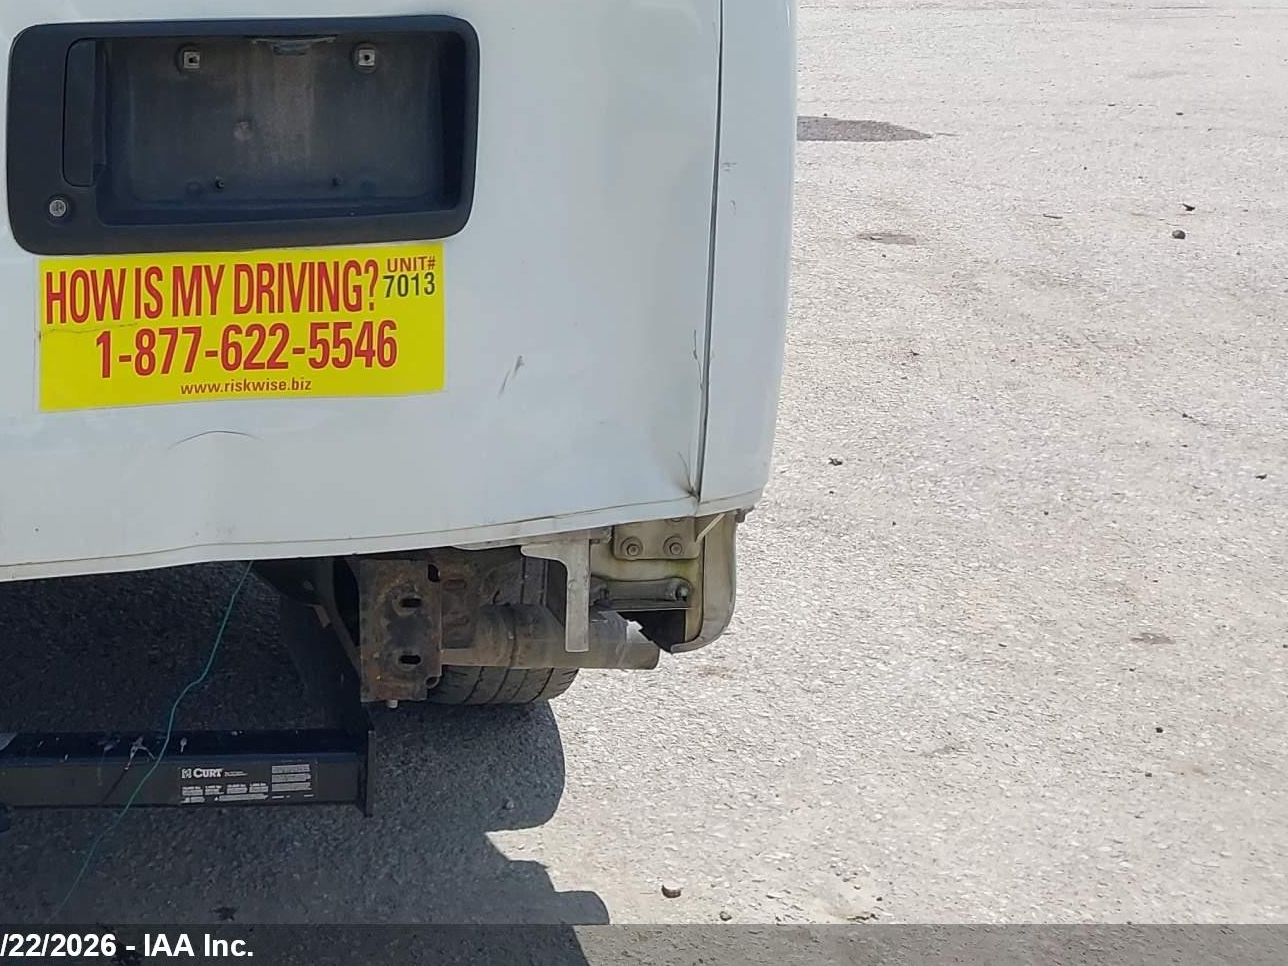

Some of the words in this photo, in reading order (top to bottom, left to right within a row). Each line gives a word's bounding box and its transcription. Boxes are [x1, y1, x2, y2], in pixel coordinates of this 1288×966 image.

[387, 256, 436, 273] UNIT#
[46, 268, 127, 324] HOW
[135, 265, 163, 320] IS
[171, 263, 225, 316] MY
[233, 259, 379, 315] DRIVING?
[383, 272, 436, 299] 7013
[95, 320, 398, 378] 1-877-622-5546
[180, 377, 312, 395] www.riskwise.biz
[193, 768, 224, 778] CURT
